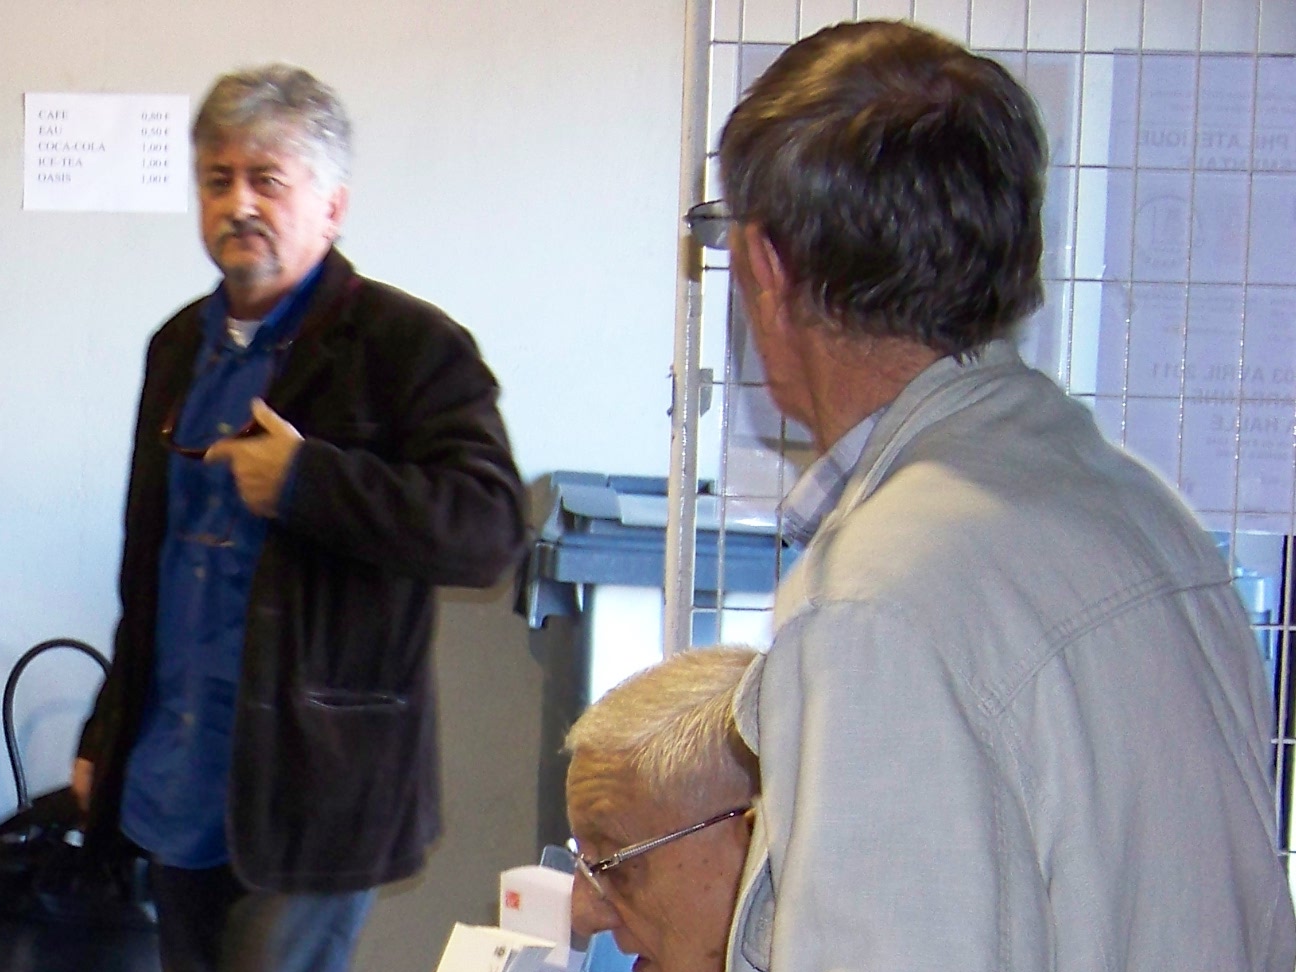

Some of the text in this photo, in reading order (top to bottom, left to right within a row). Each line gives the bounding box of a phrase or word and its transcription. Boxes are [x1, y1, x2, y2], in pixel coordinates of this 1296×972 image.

[38, 125, 63, 136] EAU
[38, 141, 106, 152] COCA-COLA
[37, 172, 72, 183] OASIS
